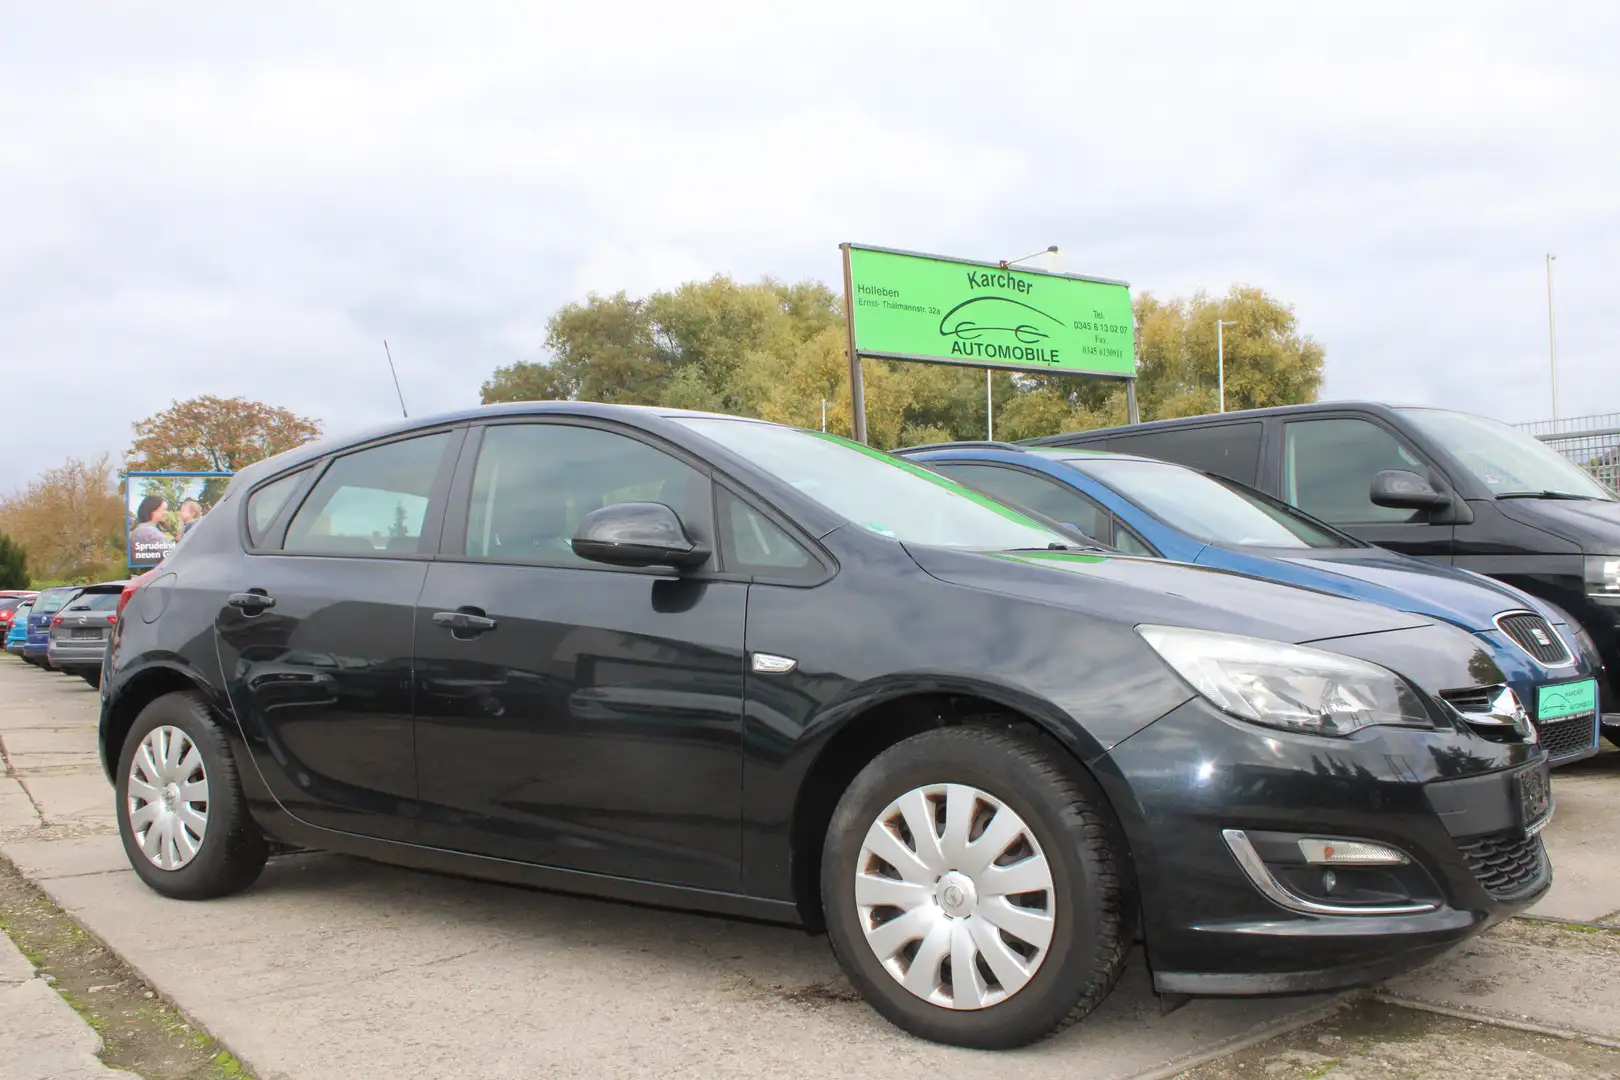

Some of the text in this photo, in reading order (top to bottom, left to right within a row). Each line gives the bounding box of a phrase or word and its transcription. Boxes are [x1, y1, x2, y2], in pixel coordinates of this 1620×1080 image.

[967, 271, 1033, 295] Karcher
[857, 284, 900, 298] Holleben
[928, 306, 941, 315] 32a
[1093, 310, 1107, 320] Tel.
[1074, 321, 1128, 334] 0345 6 13 02 07
[951, 341, 1060, 363] AUTOMOBILE
[1082, 346, 1097, 356] 0345
